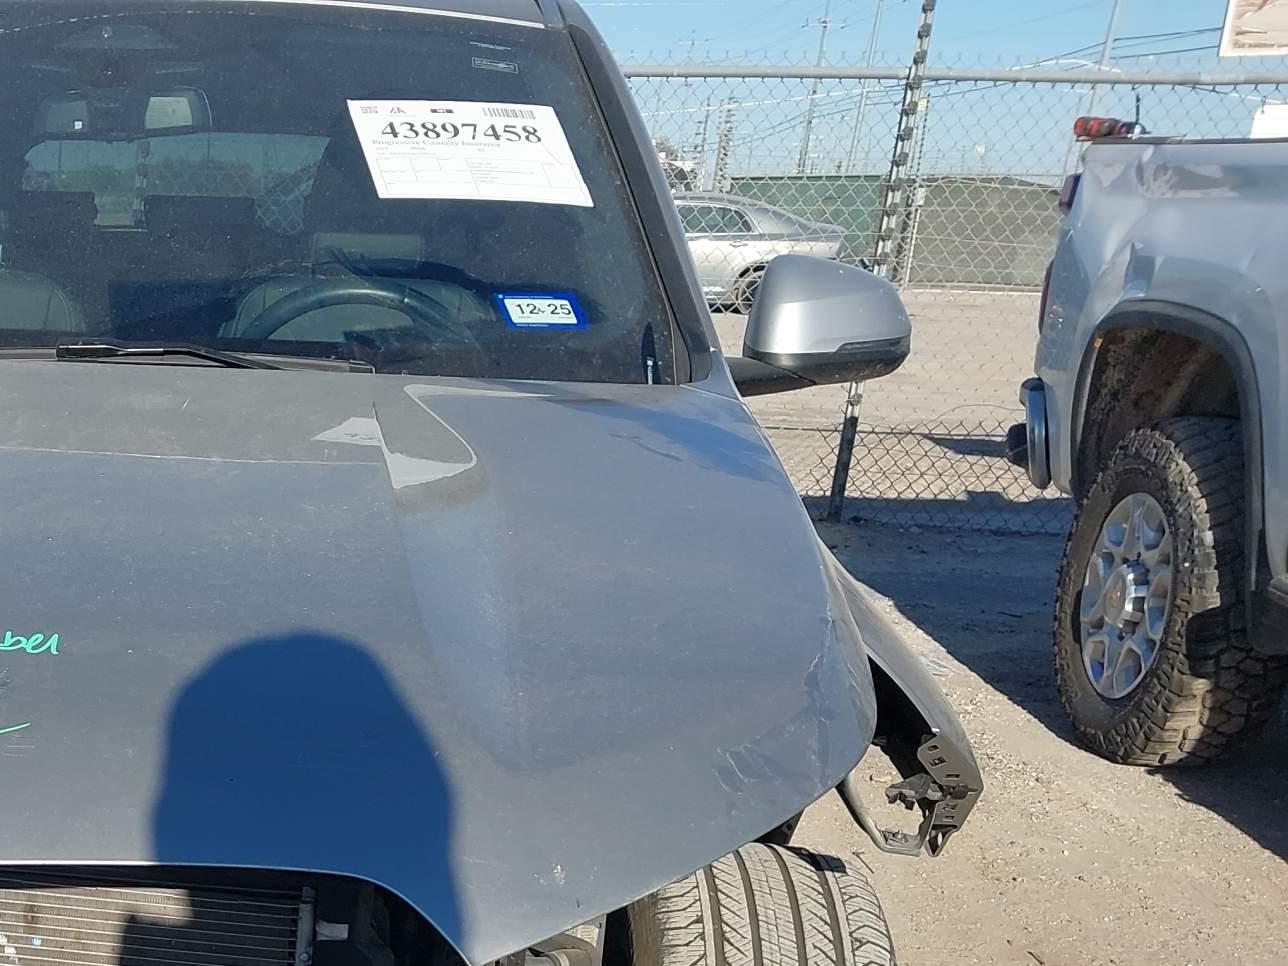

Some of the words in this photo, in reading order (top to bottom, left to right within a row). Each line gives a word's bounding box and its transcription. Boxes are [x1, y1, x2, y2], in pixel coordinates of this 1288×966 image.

[381, 121, 542, 143] 43897458
[516, 303, 539, 315] 12
[547, 303, 572, 316] 25
